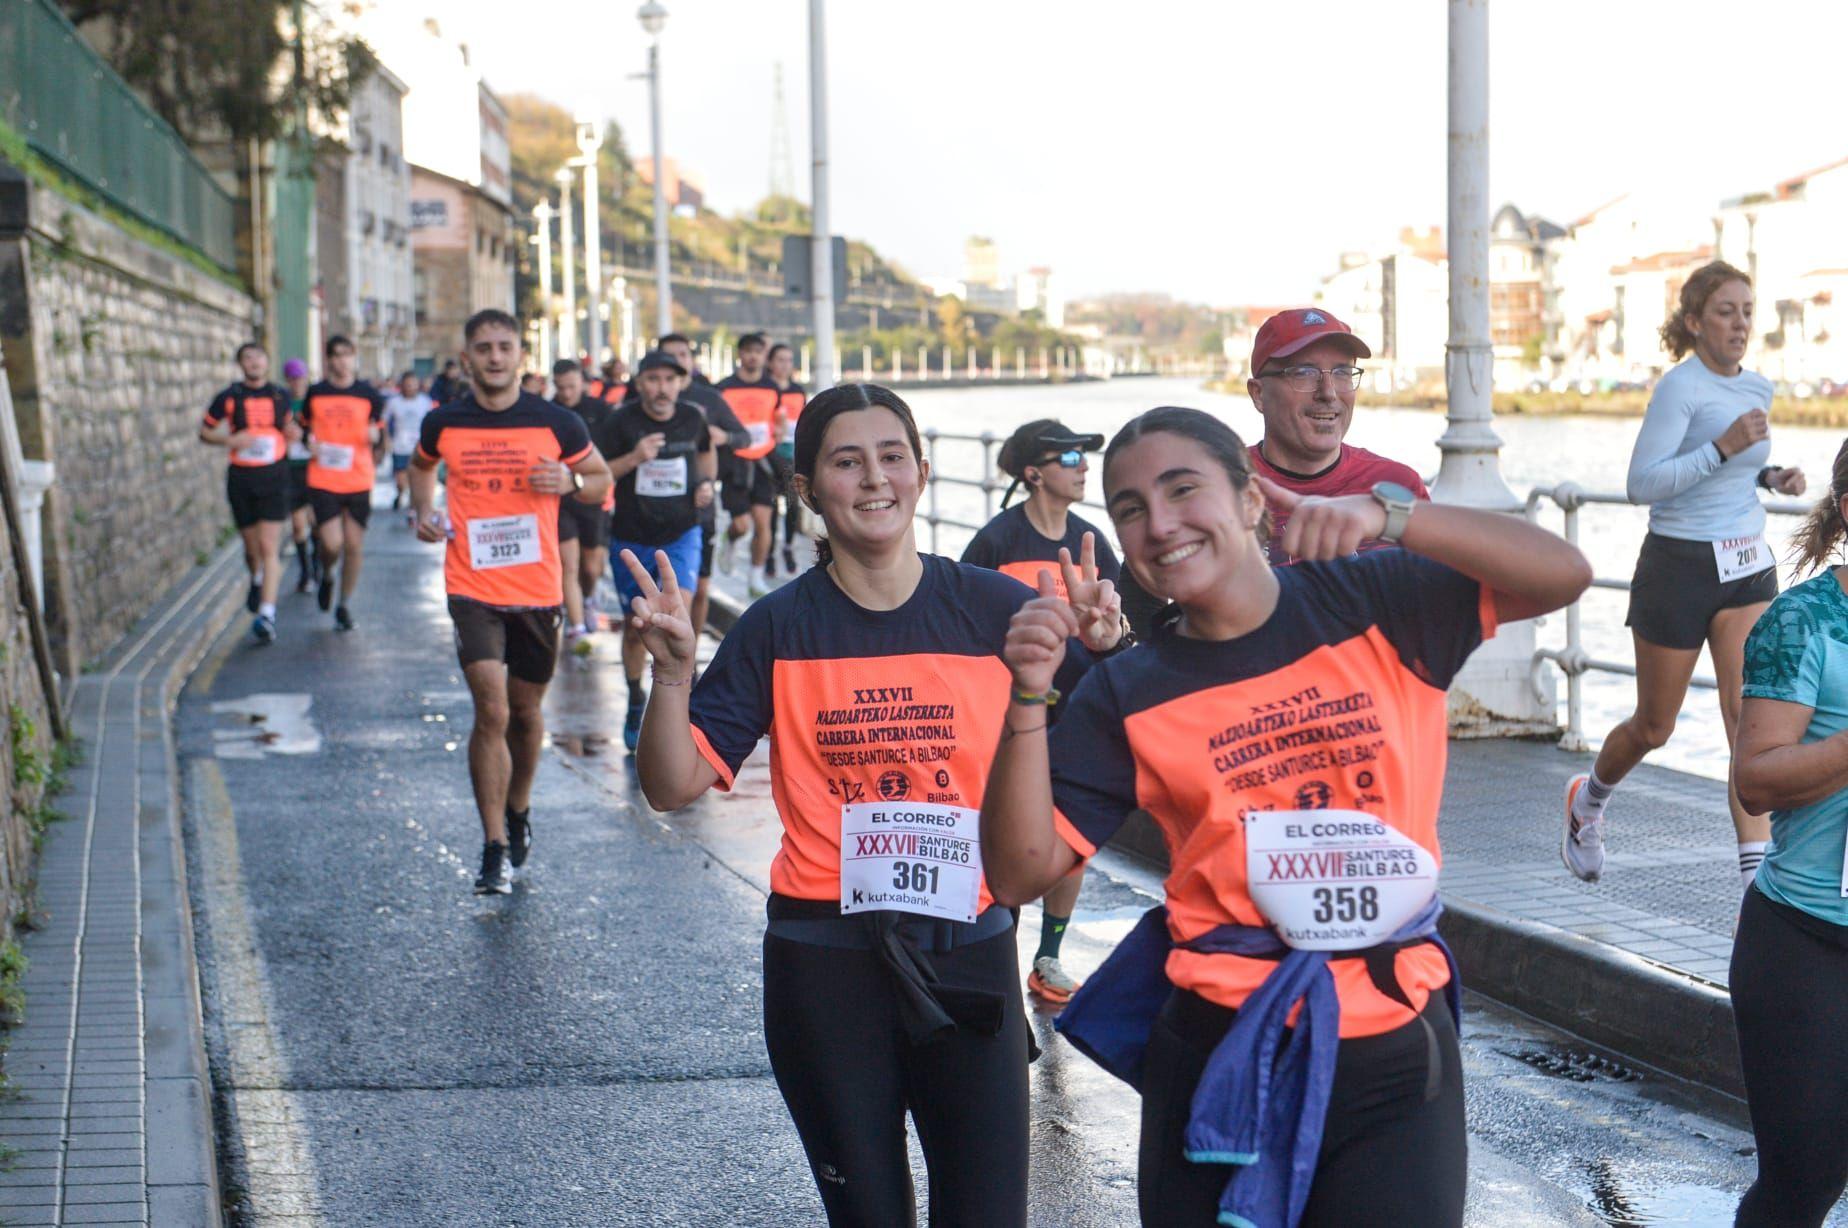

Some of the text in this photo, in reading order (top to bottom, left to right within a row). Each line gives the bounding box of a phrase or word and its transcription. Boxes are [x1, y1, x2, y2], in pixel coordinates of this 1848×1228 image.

[854, 687, 913, 704] XXXVII
[1250, 686, 1321, 715] XXXVII
[816, 705, 954, 725] NAZIOARTEKO LASTERKETA
[816, 725, 956, 746] CARRERA INTERNACIONAL
[1214, 715, 1383, 774] CARRERA INTERNACIONAL
[857, 747, 907, 766] SANTURCE
[909, 748, 917, 763] A
[1267, 749, 1328, 783] SANTURCE
[927, 792, 960, 803] Bilbao
[871, 812, 956, 827] EL CORREO
[1285, 823, 1386, 838] EL CORREO
[856, 834, 917, 856] XXXVII
[919, 835, 971, 852] SANTURCE
[919, 845, 969, 863] BILBAO
[1345, 849, 1415, 862] SANTURCE
[1267, 851, 1344, 880] XXXVII
[1346, 861, 1418, 877] BILBAO
[893, 861, 939, 895] 361
[868, 892, 929, 907] kutxabank
[1313, 886, 1379, 923] 358
[1286, 926, 1367, 941] kutxabank
